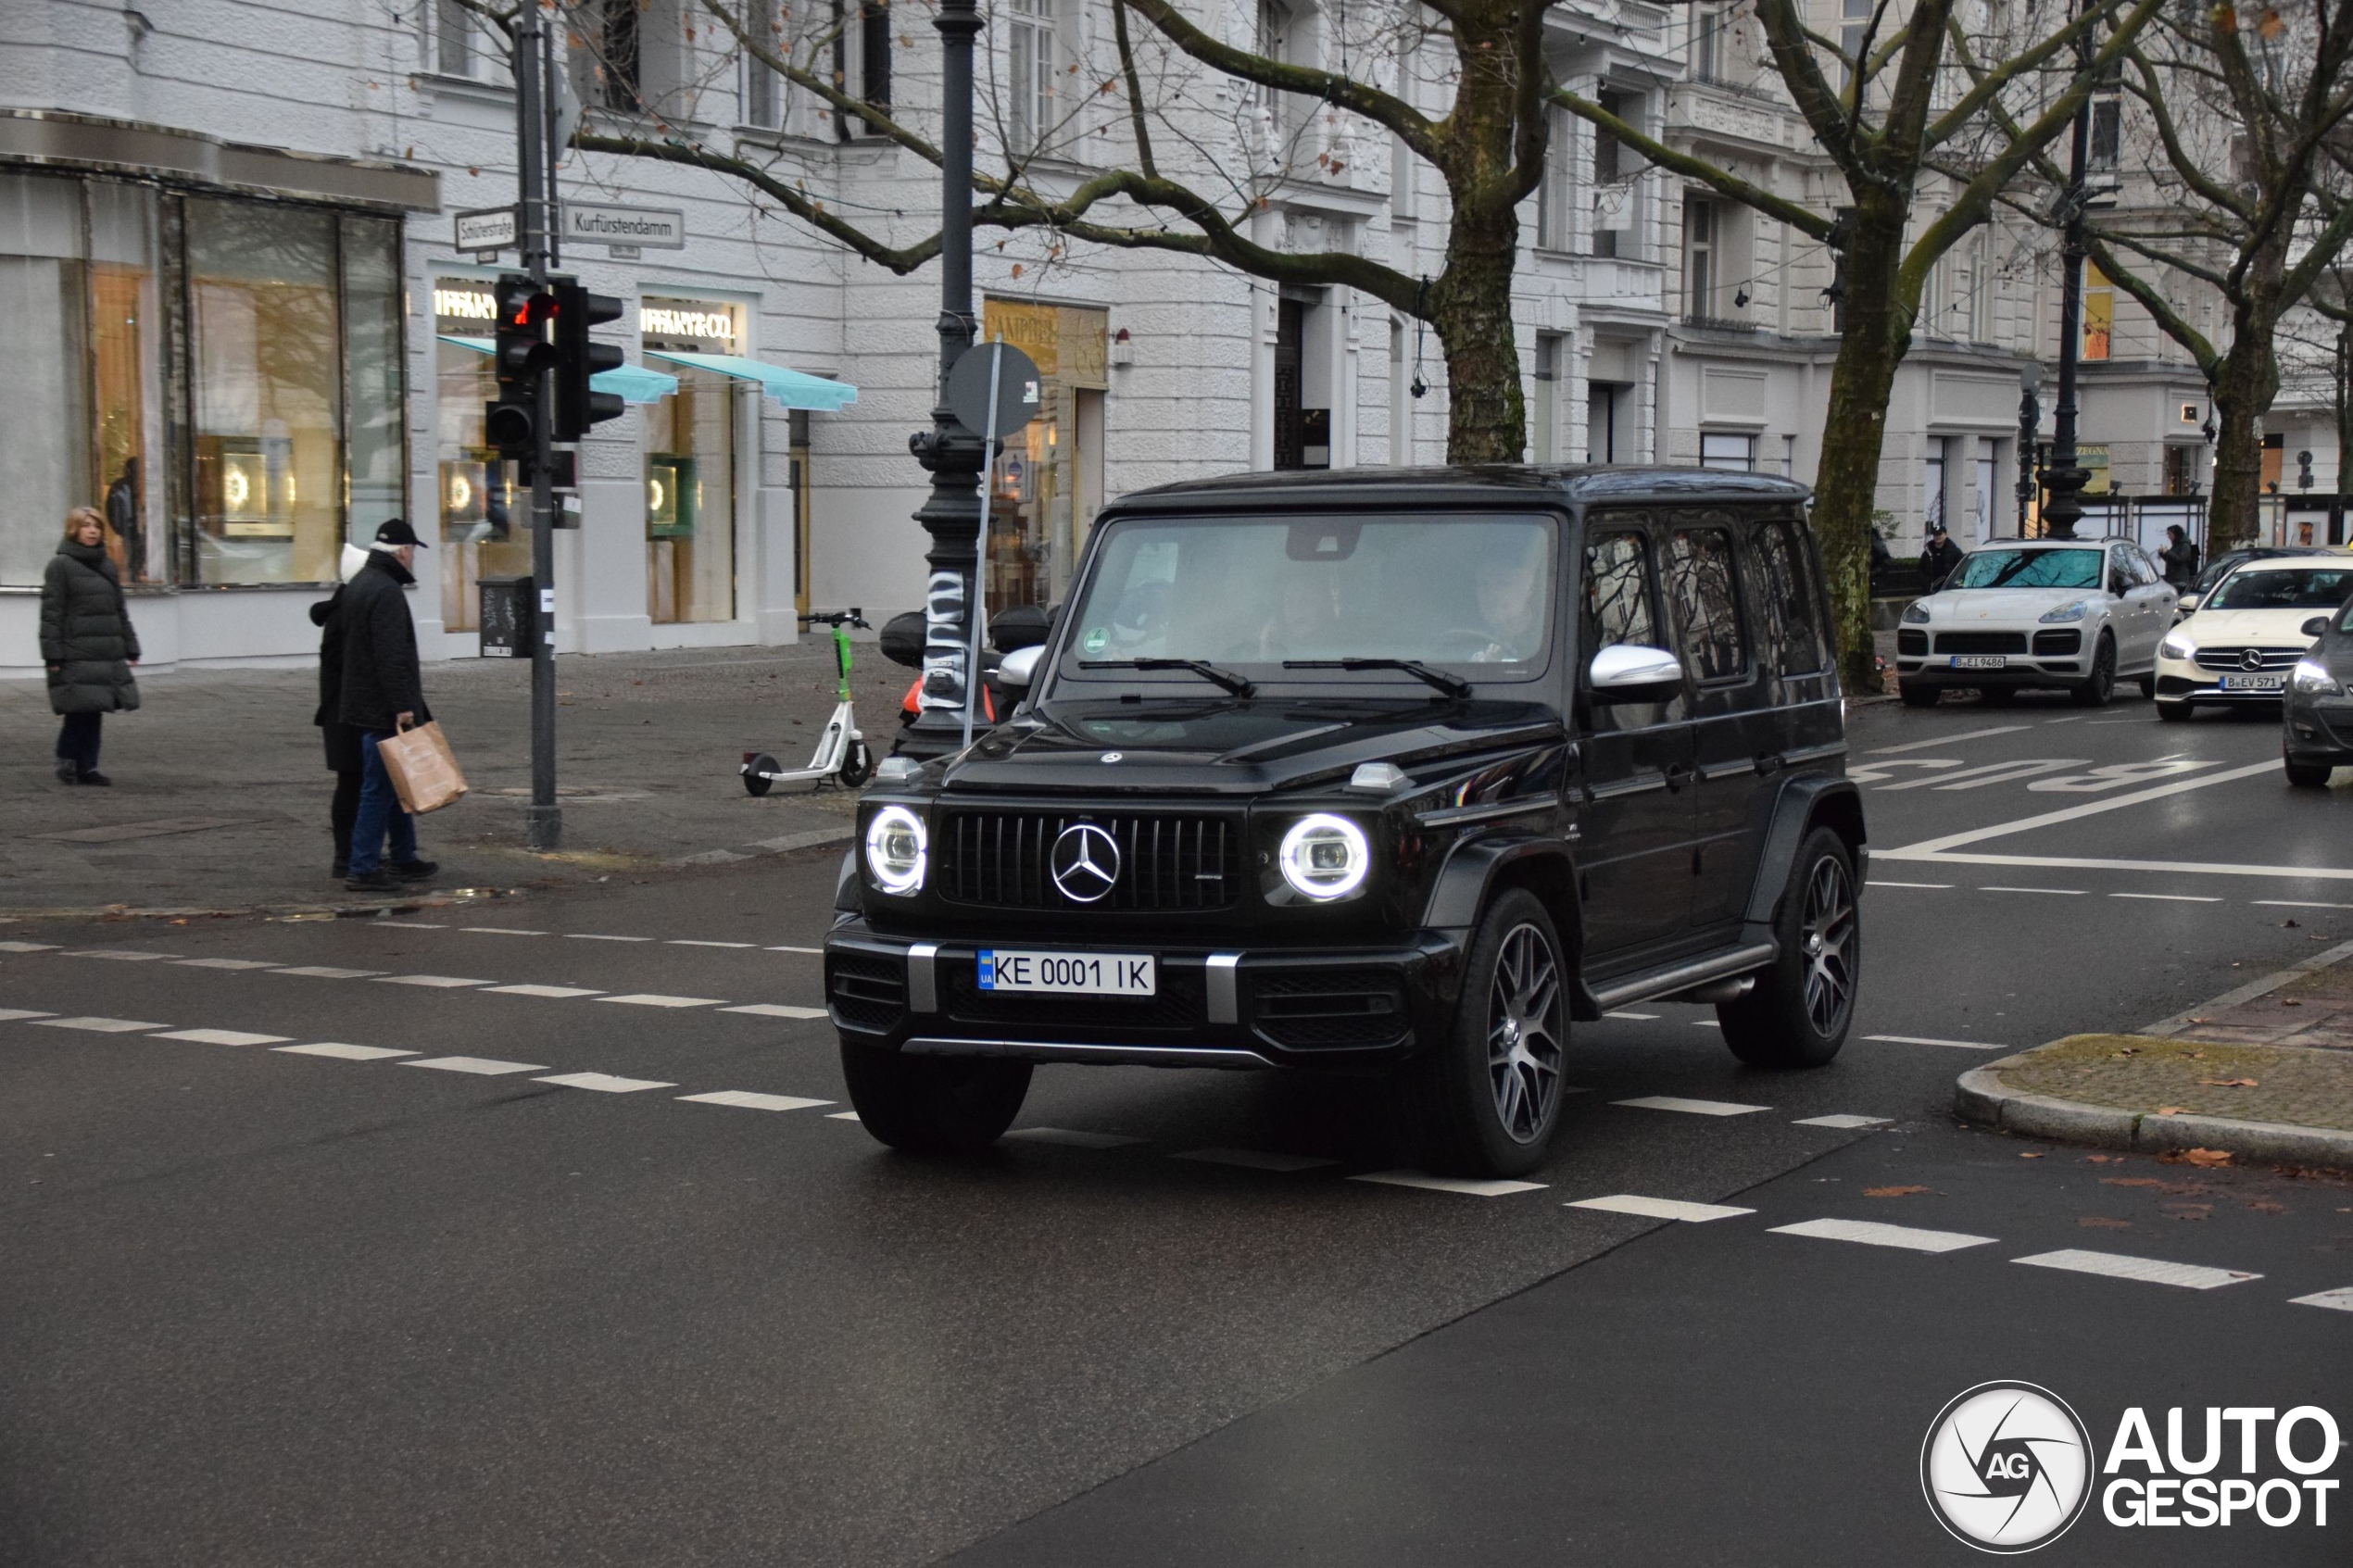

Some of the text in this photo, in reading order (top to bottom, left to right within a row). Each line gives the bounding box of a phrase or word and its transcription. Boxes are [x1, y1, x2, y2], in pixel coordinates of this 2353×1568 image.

[459, 216, 513, 240] Schlüterstraße
[574, 212, 672, 237] Kurfürstendamm
[1956, 658, 1962, 667] B
[1980, 658, 2003, 667] 9486
[2228, 677, 2276, 687] B EV 571
[980, 974, 993, 985] UA
[994, 956, 1149, 989] KE 0001 IK
